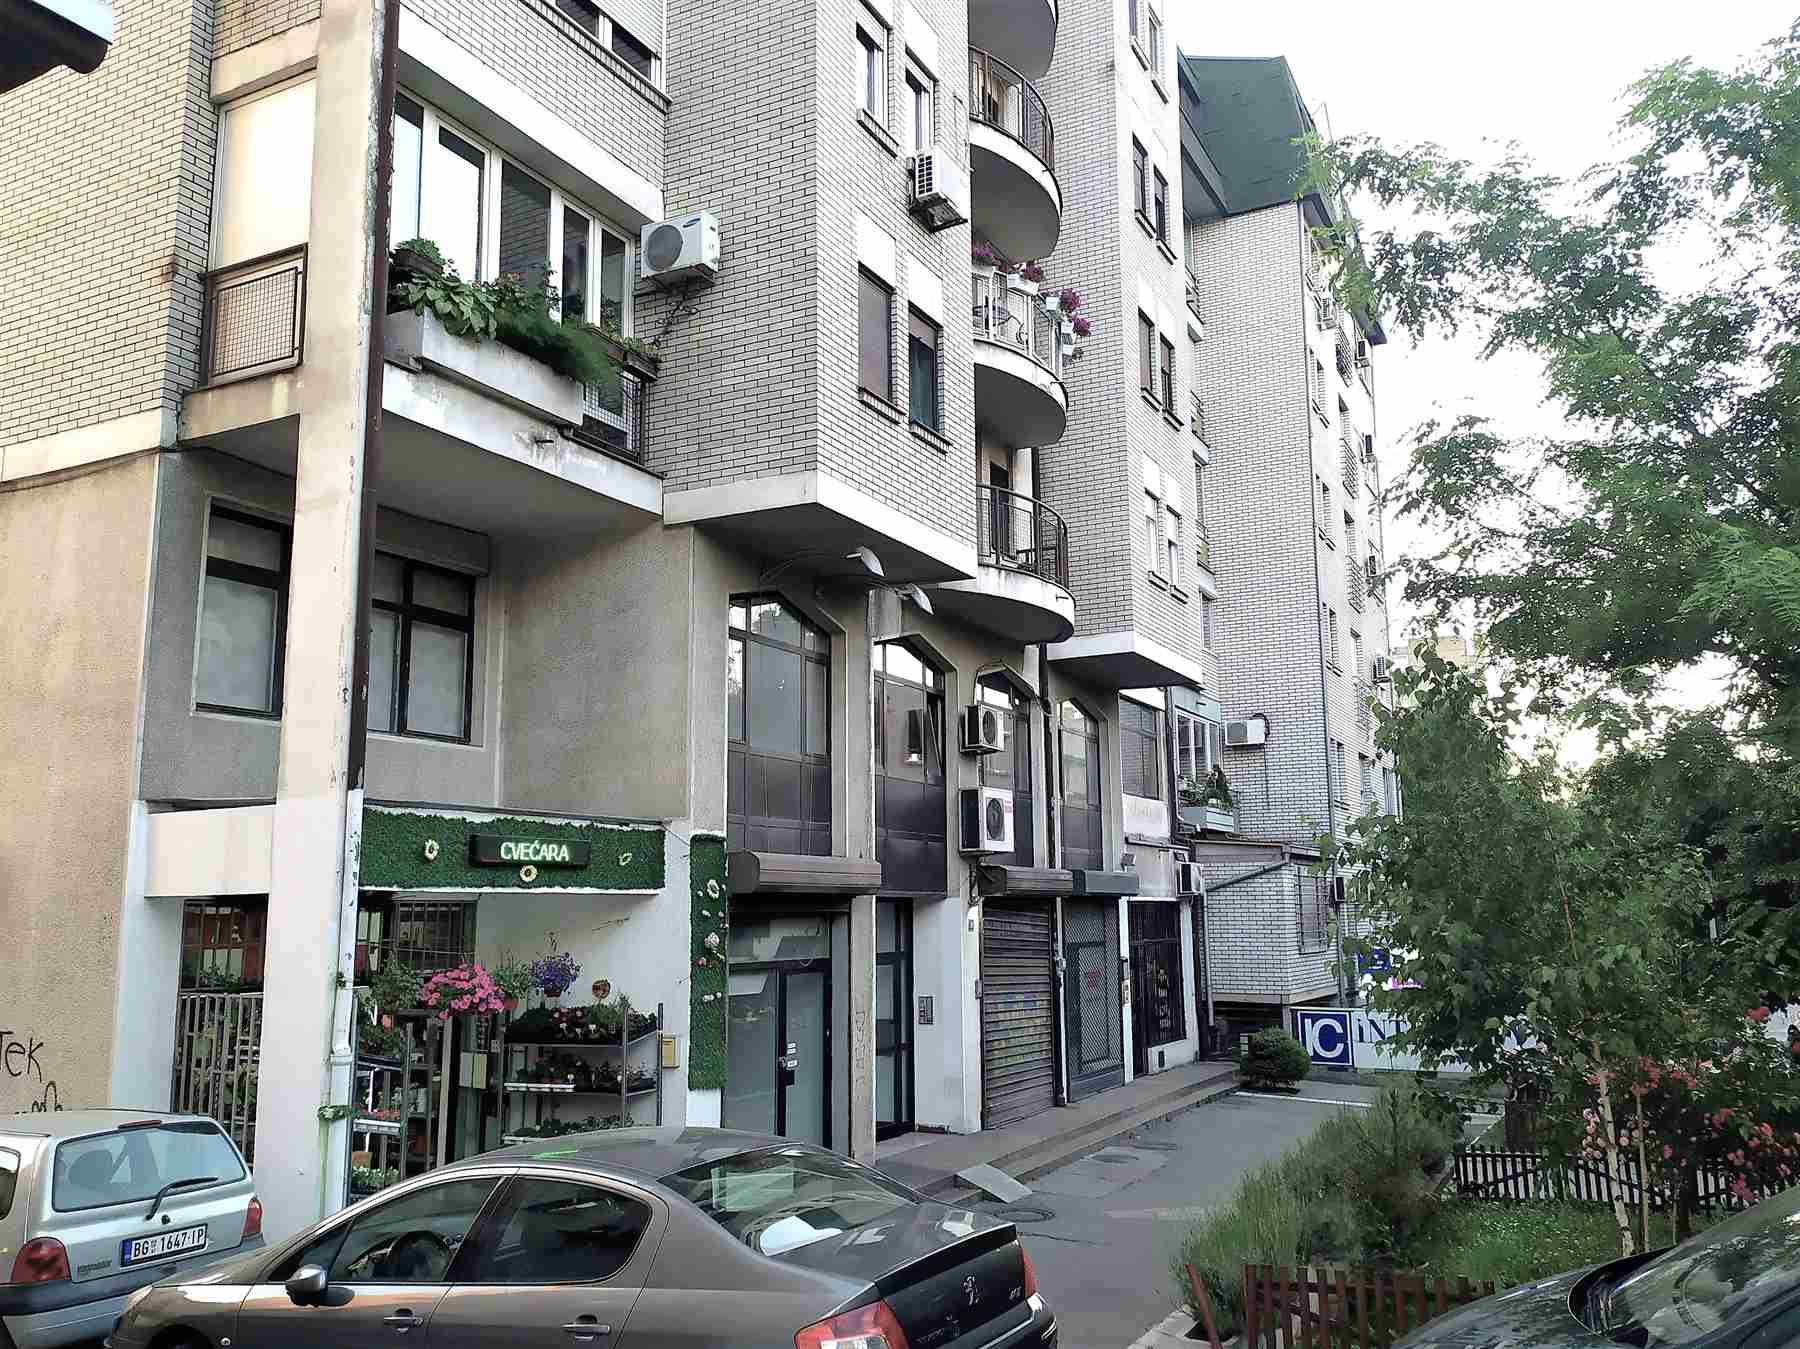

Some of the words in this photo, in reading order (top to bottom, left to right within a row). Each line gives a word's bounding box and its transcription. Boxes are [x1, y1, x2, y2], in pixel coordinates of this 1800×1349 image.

[500, 841, 570, 862] CVEĆARA
[1304, 1017, 1345, 1058] IC
[134, 1241, 149, 1258] BG
